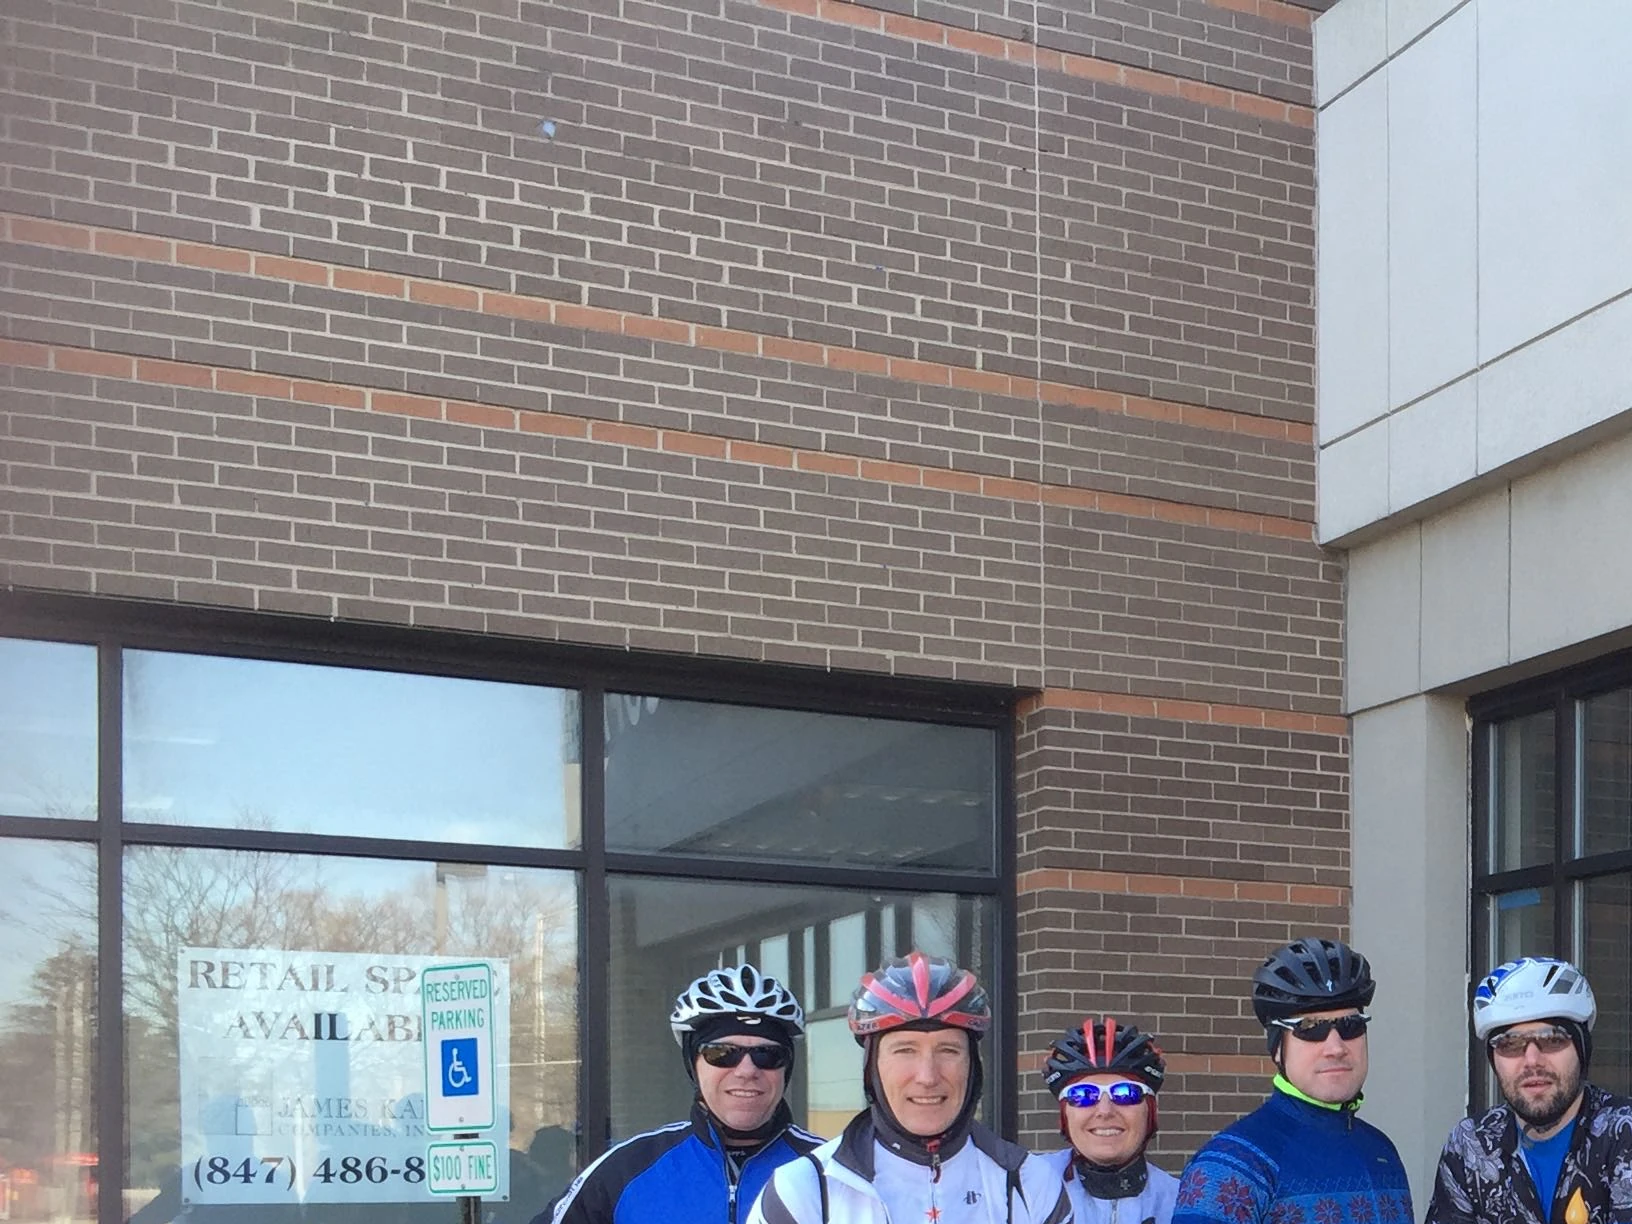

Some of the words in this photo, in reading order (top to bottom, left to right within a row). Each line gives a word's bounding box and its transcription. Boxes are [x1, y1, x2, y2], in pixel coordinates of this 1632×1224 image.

[188, 960, 350, 992] RETAIL
[426, 979, 488, 1003] RESERVED
[222, 1011, 422, 1042] AVAILAB
[431, 1008, 485, 1030] PARKING
[278, 1097, 368, 1118] JAMES
[382, 1099, 424, 1119] KA
[406, 1124, 425, 1137] IN
[194, 1156, 297, 1192] (847)
[313, 1156, 426, 1184] 486-8
[433, 1155, 461, 1181] $100
[468, 1154, 492, 1181] FINE
